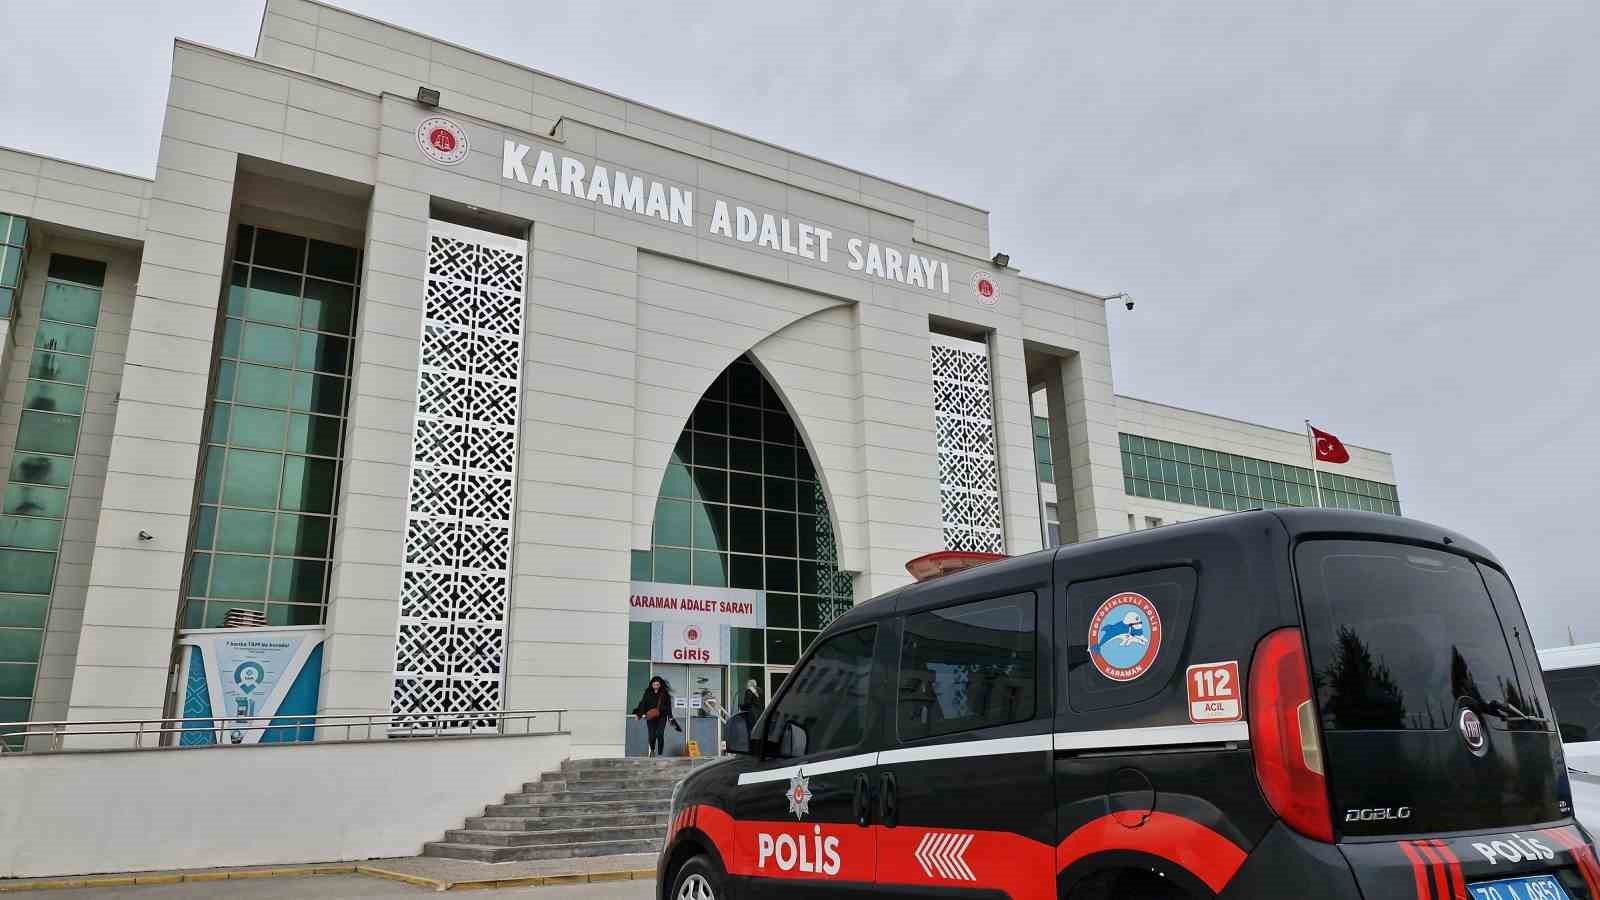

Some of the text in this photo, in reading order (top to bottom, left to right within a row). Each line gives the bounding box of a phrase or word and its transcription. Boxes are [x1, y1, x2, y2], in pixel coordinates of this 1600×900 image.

[502, 139, 950, 294] KARAMAN ADALET SARAYI
[680, 599, 717, 612] ADALET
[720, 602, 753, 614] SARAYI
[673, 646, 710, 663] GİRİŞ
[1105, 666, 1142, 678] KARAMAN
[1194, 669, 1232, 697] 112
[1345, 806, 1411, 822] DOBLO
[759, 824, 840, 875] POLİS
[1472, 833, 1554, 864] POLİS
